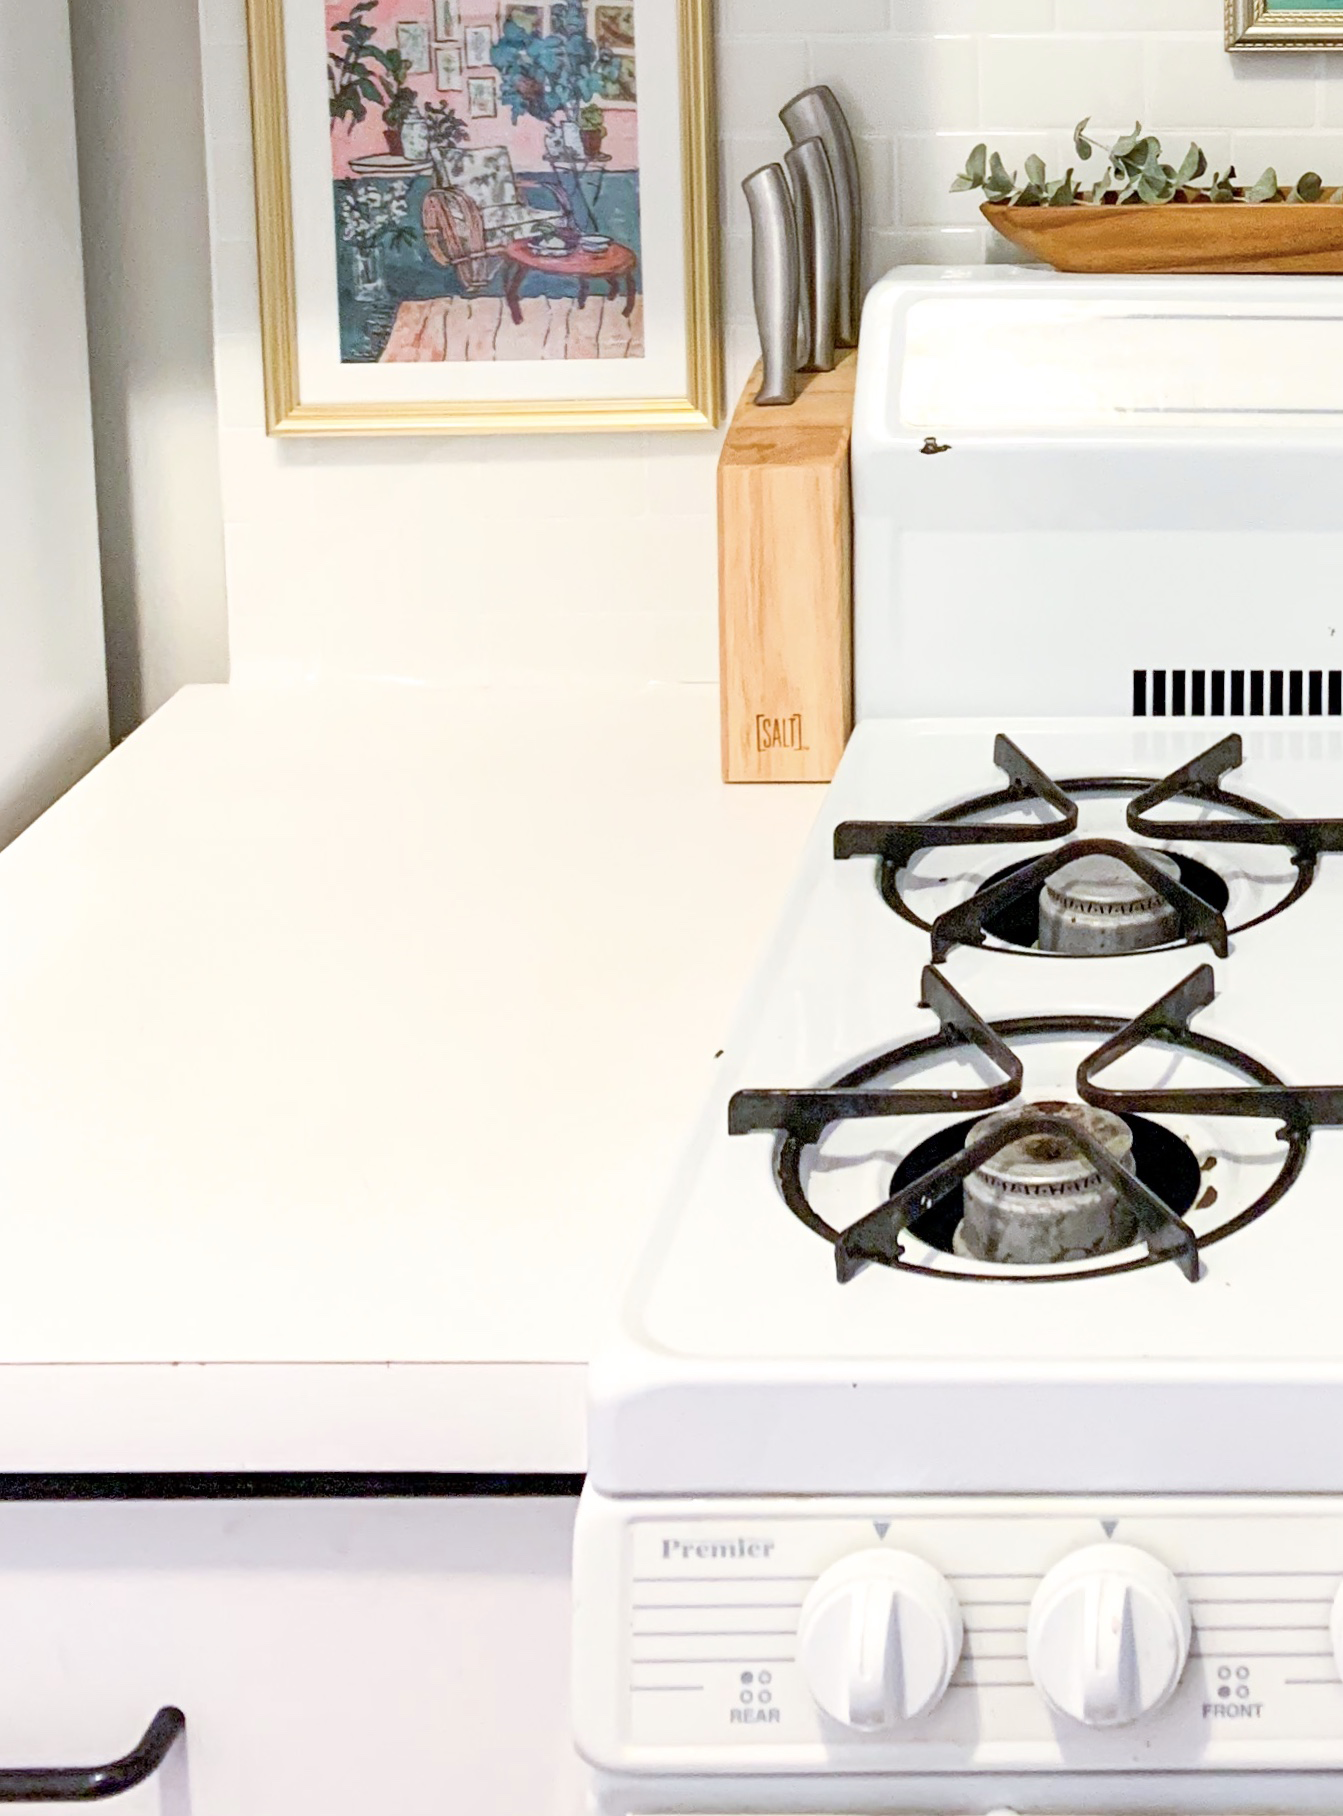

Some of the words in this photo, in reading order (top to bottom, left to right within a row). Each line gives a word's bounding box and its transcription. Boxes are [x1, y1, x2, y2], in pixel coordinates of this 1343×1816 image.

[662, 1536, 776, 1560] Premier
[729, 1708, 781, 1725] REAR
[1202, 1703, 1263, 1719] FRONT
